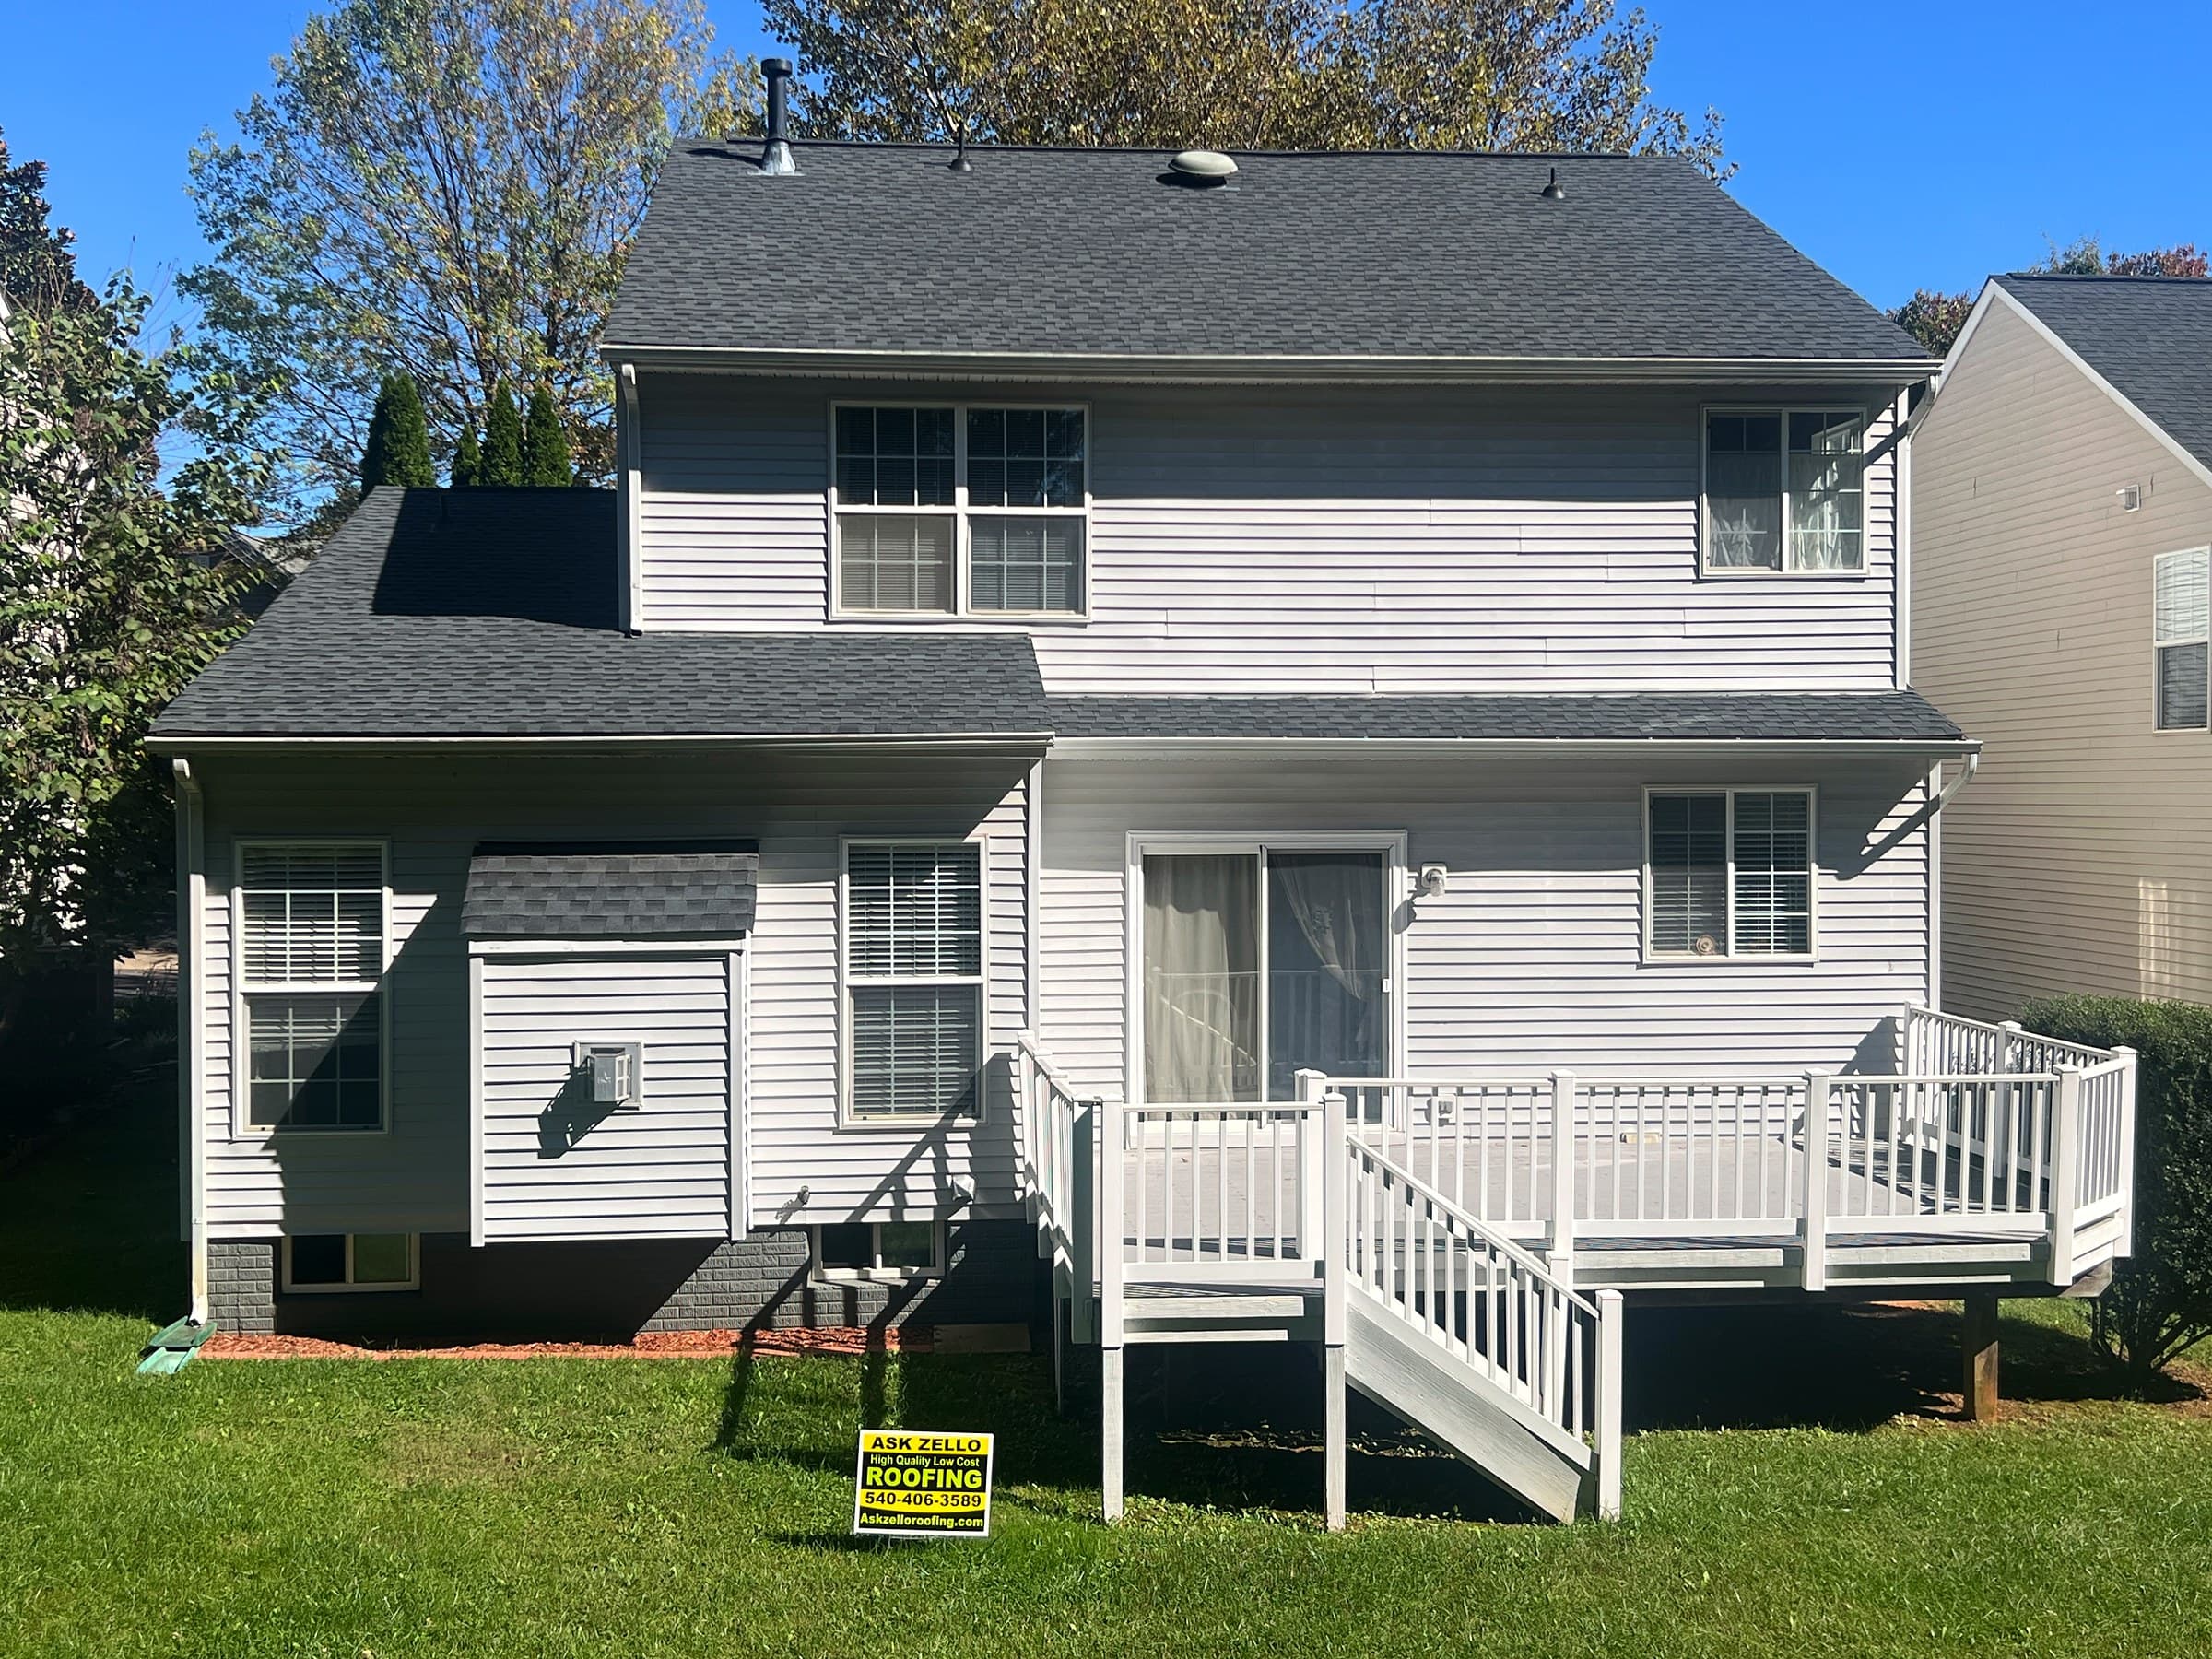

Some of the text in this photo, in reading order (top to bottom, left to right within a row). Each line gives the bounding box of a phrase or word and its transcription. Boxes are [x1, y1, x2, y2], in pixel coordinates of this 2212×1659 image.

[871, 1437, 982, 1452] ASK ZELLO
[870, 1453, 980, 1467] High Quality Low Cost
[865, 1466, 982, 1488] ROOFING
[865, 1491, 982, 1507] 540-406-3589
[860, 1512, 983, 1529] Askzelloroofing.com
